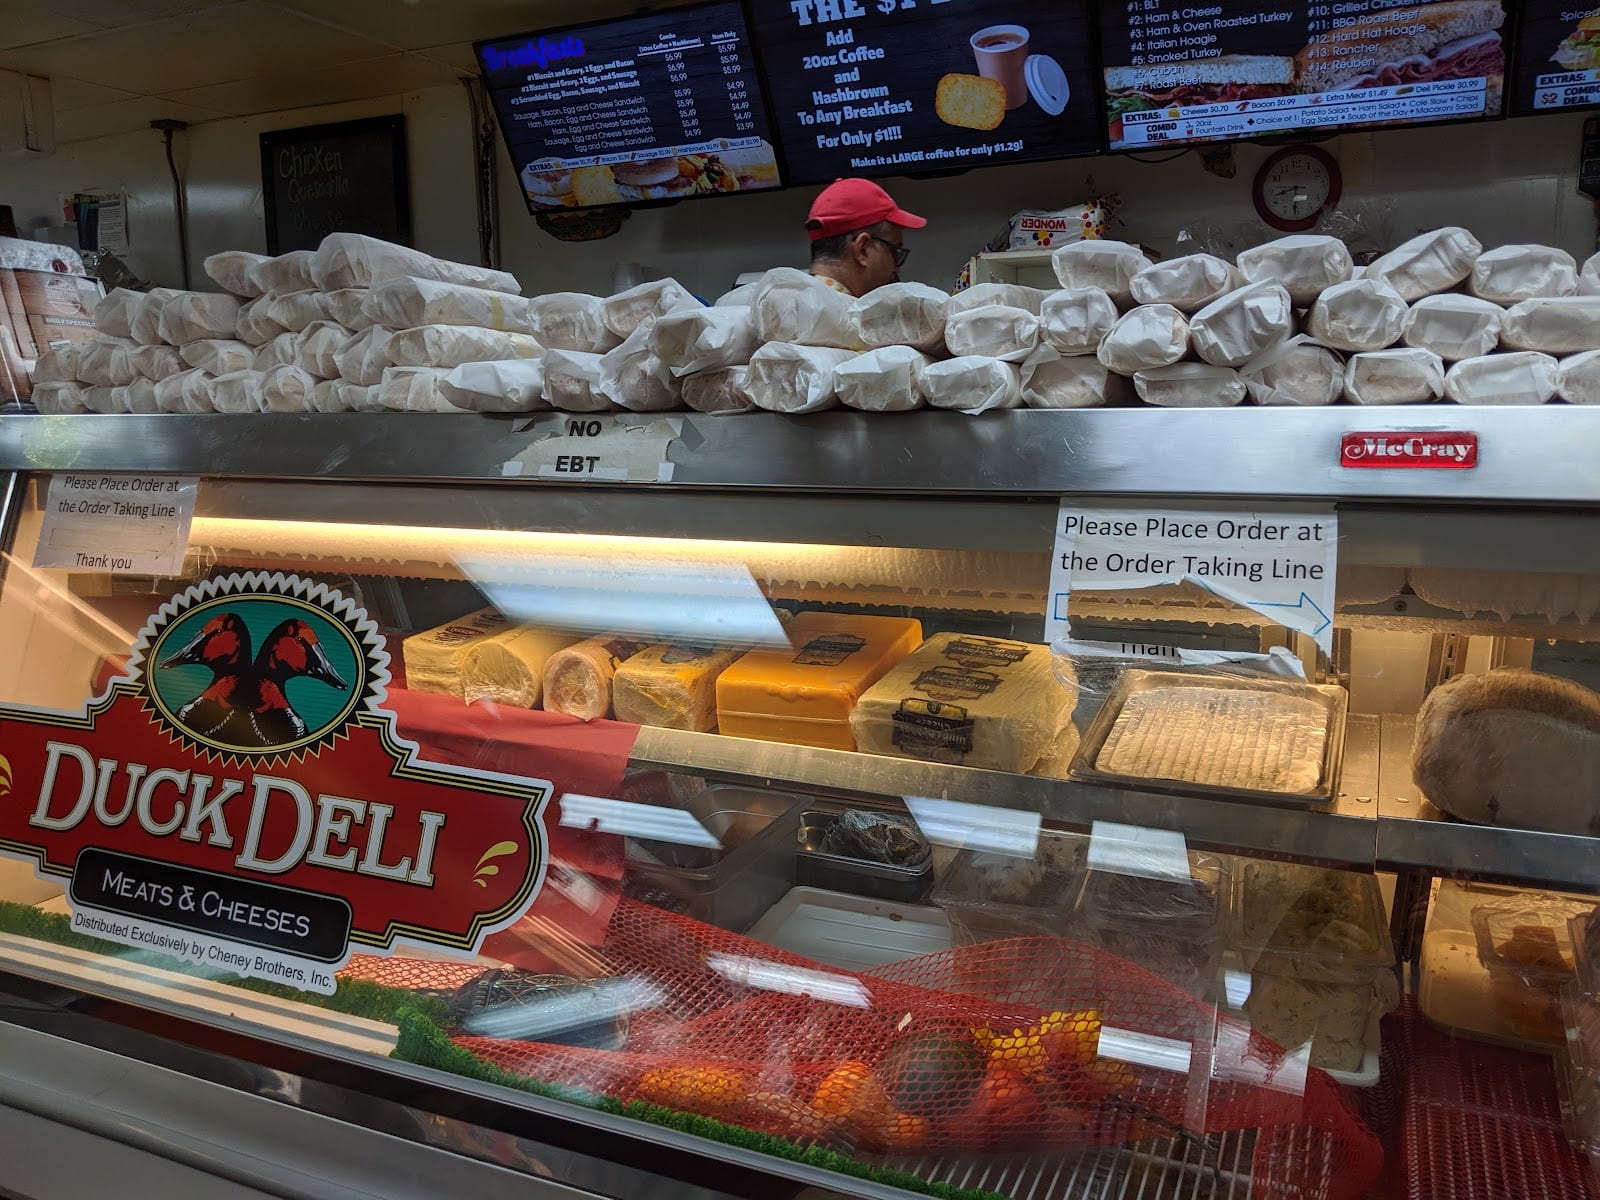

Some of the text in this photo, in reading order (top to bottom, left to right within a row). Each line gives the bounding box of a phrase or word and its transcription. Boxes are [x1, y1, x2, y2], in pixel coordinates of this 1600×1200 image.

[790, 0, 866, 26] THE
[1128, 6, 1222, 26] #2: Ham & Cheese
[1333, 2, 1368, 14] Grilled
[1130, 11, 1293, 39] #3: Ham & Oven Roasted Turkey
[1333, 17, 1355, 28] BBQ
[1359, 15, 1389, 24] Roast
[1392, 10, 1419, 20] Beef
[826, 28, 854, 46] Add
[1332, 31, 1359, 42] Hard
[1361, 28, 1382, 39] Hat
[1385, 23, 1425, 36] Hoagie
[1130, 34, 1217, 51] #4: Italian Hoagie
[1332, 44, 1380, 57] Rancher
[803, 46, 885, 69] 20oz Coffee
[1131, 47, 1223, 65] #5: Smoked Turkey
[1333, 58, 1374, 70] Reuben
[834, 66, 860, 83] and
[1150, 66, 1184, 77] Cuban
[1540, 73, 1586, 85] EXTRAS:
[812, 85, 890, 105] Hashbrown
[1563, 95, 1590, 105] DEAL
[798, 99, 913, 125] To Any Breakfast
[1125, 112, 1162, 121] EXTRAS:
[1181, 108, 1208, 116] Cheese
[1251, 101, 1275, 109] Bacon
[1327, 94, 1344, 102] Extra
[1346, 91, 1366, 99] Meat
[1146, 123, 1177, 133] COMBO
[1256, 117, 1283, 125] Choice
[817, 134, 839, 149] For
[841, 131, 872, 147] Only
[1147, 132, 1169, 141] DEAL
[851, 157, 876, 168] Make
[877, 155, 885, 164] it
[892, 151, 924, 164] LARGE
[925, 148, 954, 159] coffee
[955, 147, 970, 157] for
[971, 144, 992, 156] only
[993, 140, 1023, 153] $1.29!
[1021, 218, 1066, 230] WONDER
[569, 421, 602, 437] NO
[1345, 437, 1473, 462] McCray
[555, 455, 600, 473] EBT
[64, 475, 179, 492] Please Place Order at
[58, 499, 175, 519] the Order Taking Line
[1065, 516, 1323, 542] Please Place Order at
[76, 552, 132, 571] Thank you
[1061, 551, 1323, 583] the Order Taking Line
[179, 885, 196, 912] &
[74, 912, 333, 989] Distributed Exclusively by Cheney Brothers, Inc.
